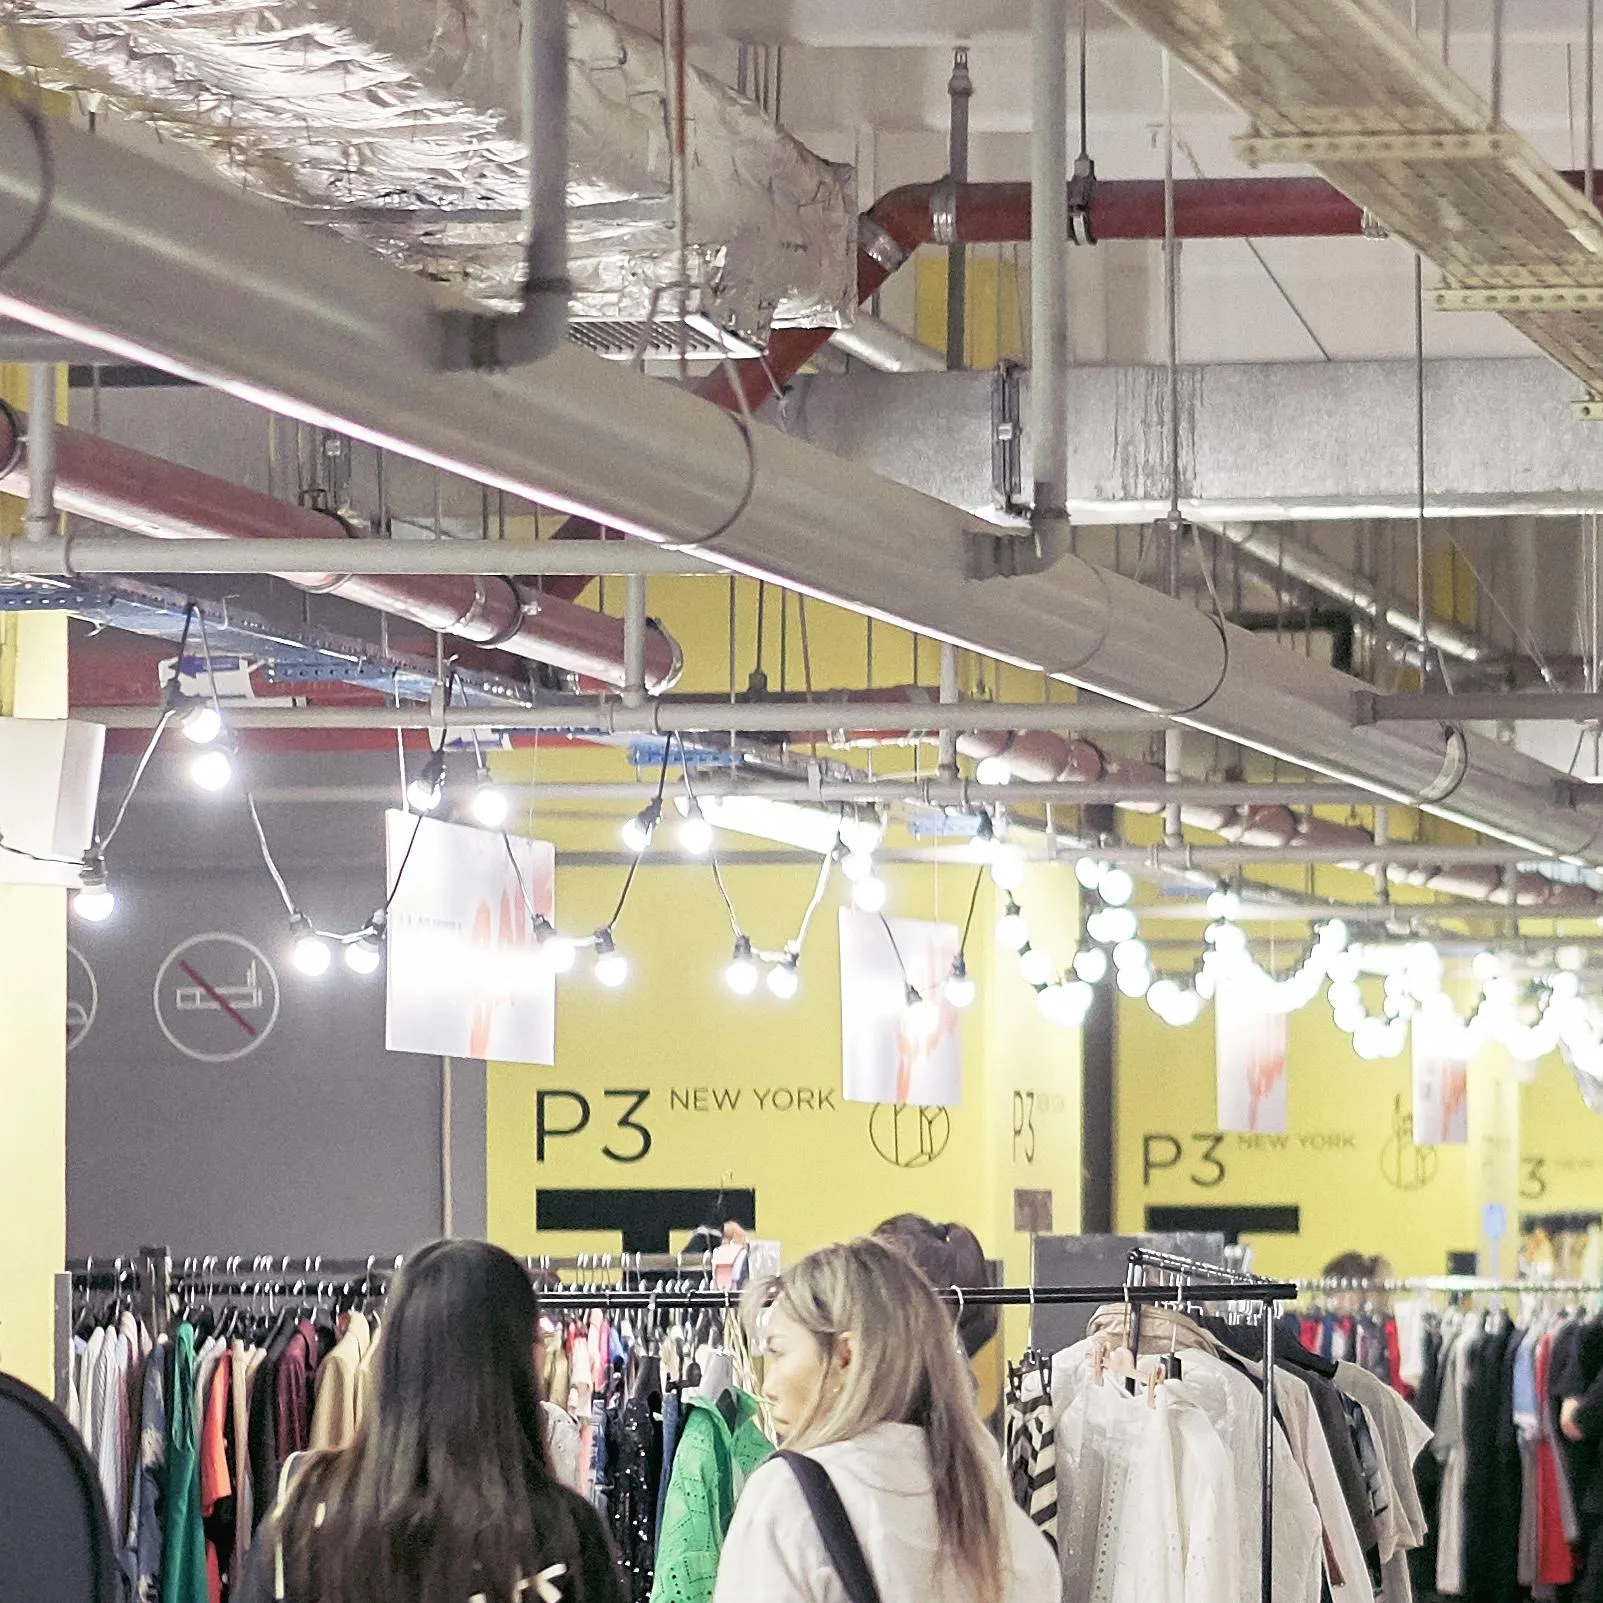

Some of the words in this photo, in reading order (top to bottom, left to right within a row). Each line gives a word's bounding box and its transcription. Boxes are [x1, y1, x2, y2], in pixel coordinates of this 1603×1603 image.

[536, 1088, 652, 1164] P3
[670, 1087, 741, 1111] NEW
[753, 1087, 837, 1111] YORK
[1013, 1090, 1035, 1164] P3
[1143, 1134, 1226, 1188] P3
[1237, 1134, 1290, 1150] NEW
[1298, 1134, 1356, 1150] YORK
